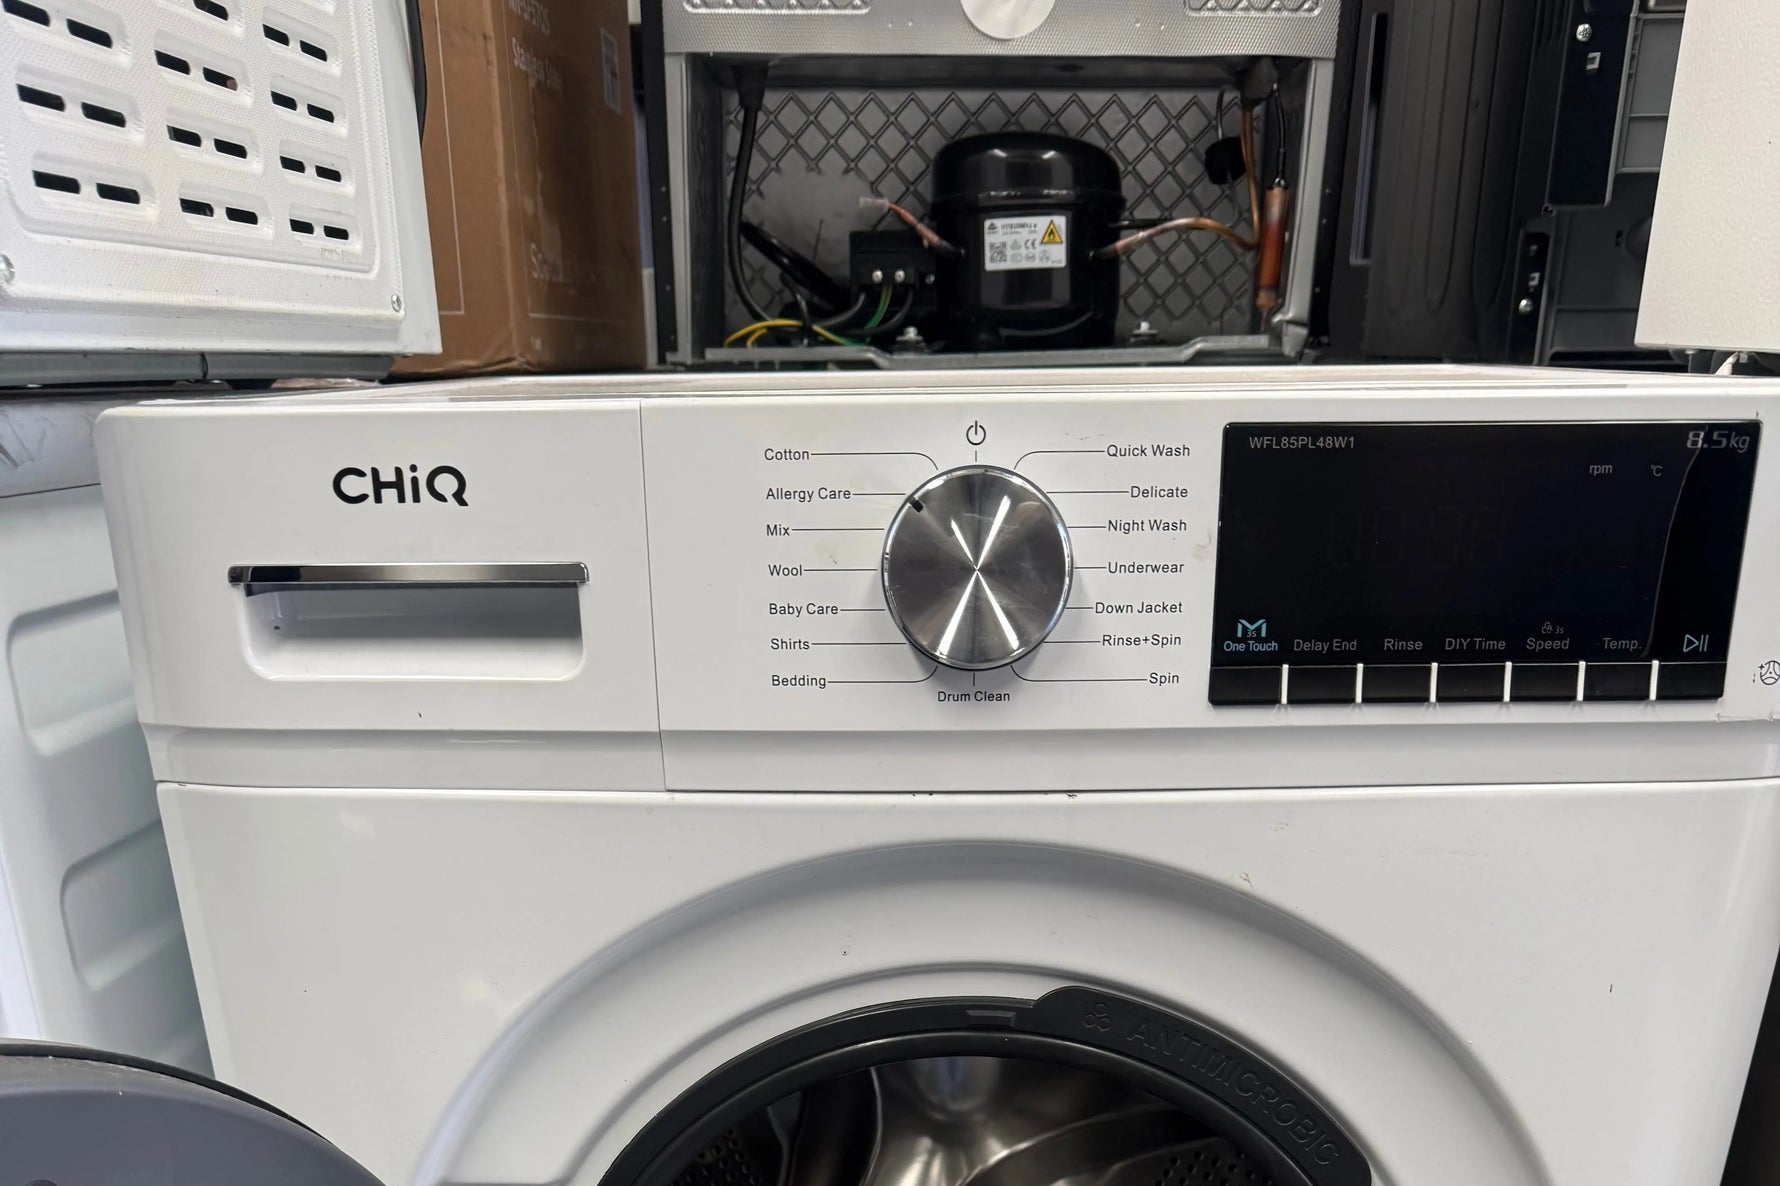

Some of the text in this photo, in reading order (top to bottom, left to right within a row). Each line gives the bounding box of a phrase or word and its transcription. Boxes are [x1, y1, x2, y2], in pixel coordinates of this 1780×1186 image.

[1250, 437, 1353, 448] WFL85PL48W1
[765, 449, 809, 460] Cotton
[1107, 444, 1190, 457] Quick Wash
[1590, 465, 1612, 476] rpm
[333, 464, 469, 506] CHiQ
[766, 487, 850, 502] Allergy Care
[1131, 486, 1187, 497] Delicate
[767, 525, 789, 535] Mix
[1109, 520, 1186, 534] Night Wash
[769, 565, 802, 576] Wool
[1109, 562, 1184, 573] Underwear
[770, 603, 838, 617] Baby Care
[1096, 602, 1182, 613] Down Jacket
[771, 638, 809, 649] Shirts
[1103, 634, 1181, 648] Rinse+Spin
[1224, 641, 1278, 651] One Touch
[1294, 639, 1356, 653] Delay End
[1384, 639, 1422, 650] Rinse
[1446, 638, 1505, 649] DIY Time
[1527, 638, 1569, 651] Speed
[1603, 638, 1641, 651] Temp.
[772, 675, 825, 689] Bedding
[1150, 673, 1179, 686] Spin
[938, 691, 1009, 701] Drum Clean
[1126, 1018, 1339, 1165] ANTIMICROBIC
